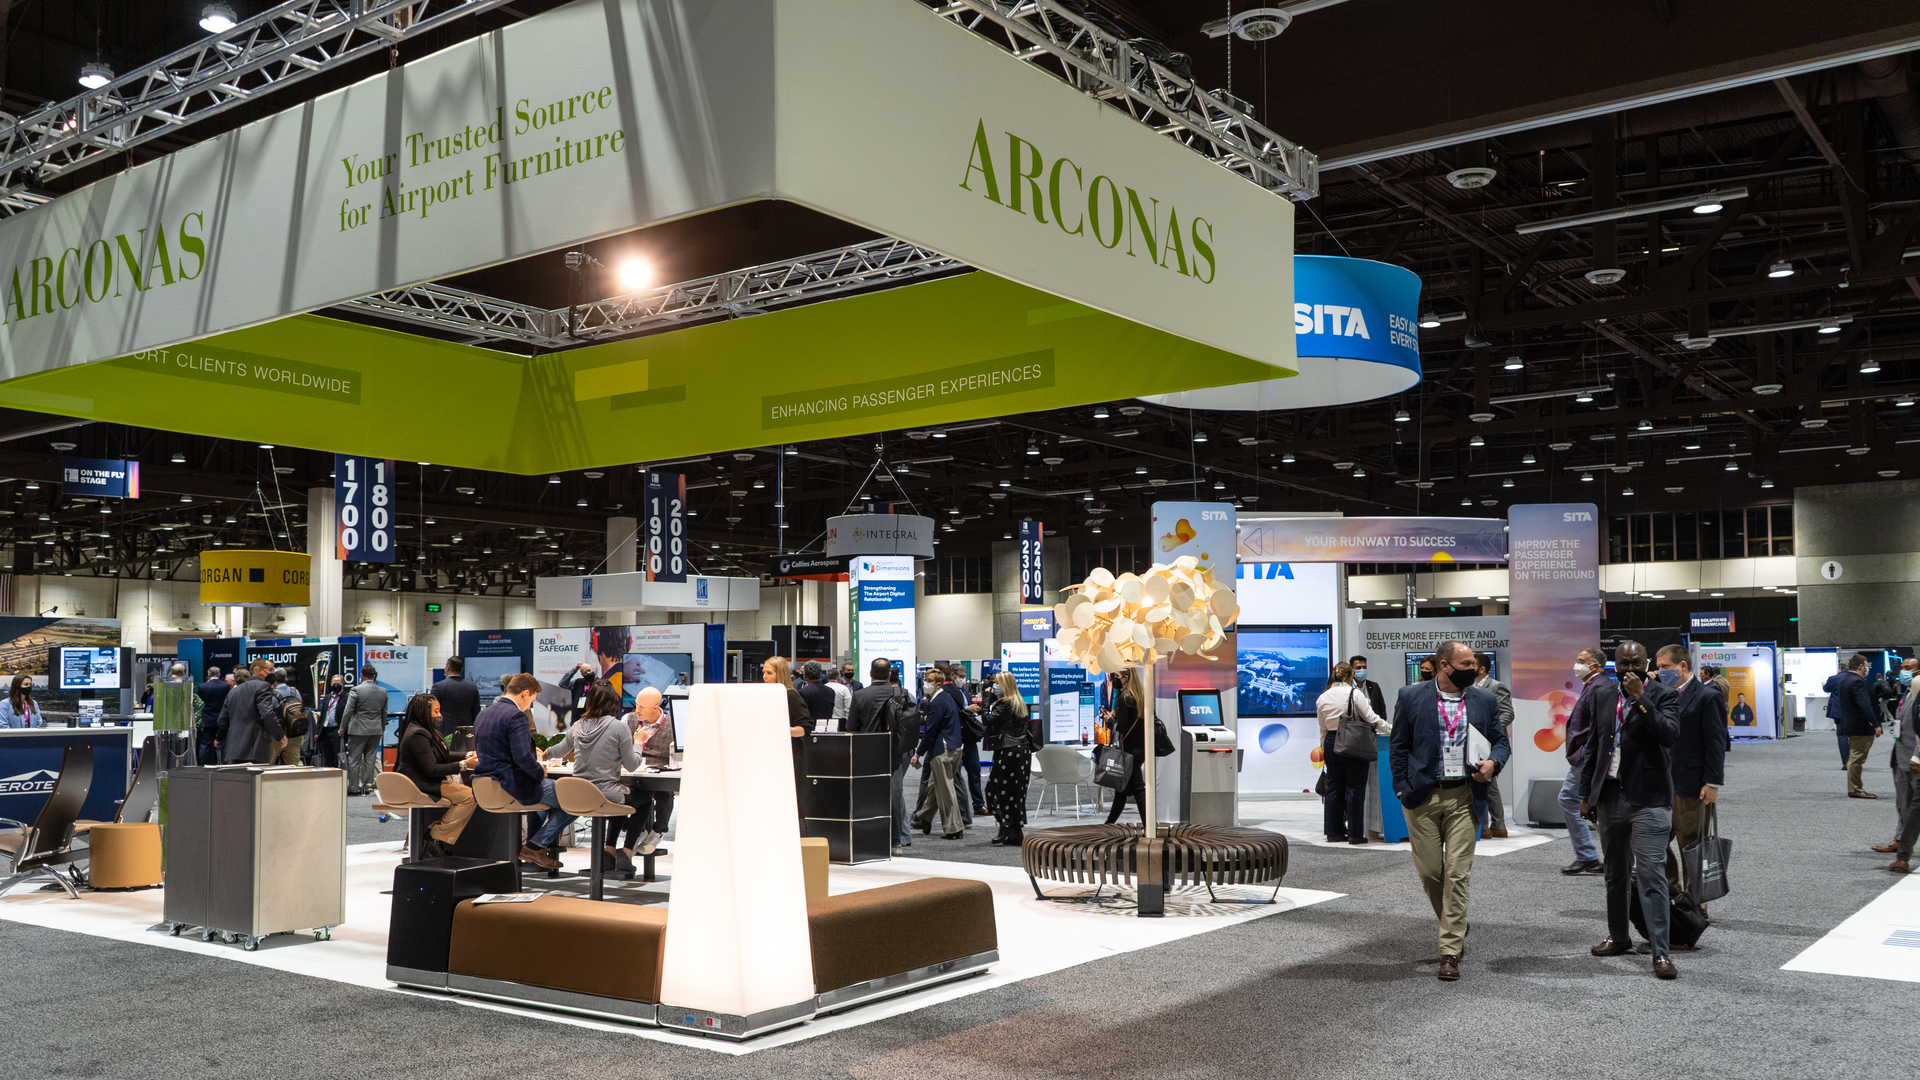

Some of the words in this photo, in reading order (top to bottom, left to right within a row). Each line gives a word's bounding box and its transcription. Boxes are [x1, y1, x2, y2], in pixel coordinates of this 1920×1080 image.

[341, 153, 397, 189] Your
[405, 106, 505, 168] Trusted
[515, 86, 612, 136] Source
[338, 199, 371, 232] for
[378, 169, 475, 219] Airport
[482, 129, 626, 191] Furniture
[958, 117, 1216, 285] ARCONAS
[2, 210, 206, 325] ARCONAS
[1294, 303, 1370, 340] SITA
[1389, 313, 1409, 332] EASY
[1390, 330, 1413, 350] EVERY
[176, 353, 247, 377] CLIENTS
[253, 365, 351, 394] WORLDWIDE
[771, 397, 848, 420] ENHANCING
[852, 383, 936, 409] PASSENGER
[940, 363, 1042, 395] EXPERIENCES
[80, 469, 93, 477] ON
[94, 469, 110, 478] THE
[110, 471, 125, 479] FLY
[80, 476, 107, 485] STAGE
[341, 458, 359, 550] 1700
[371, 462, 388, 552] 1800
[1202, 510, 1228, 521] SITA
[1563, 512, 1592, 522] SITA
[649, 497, 662, 574] 1900
[670, 499, 682, 575] 2000
[866, 529, 918, 540] INTEGRAL
[1304, 536, 1337, 547] YOUR
[1340, 536, 1390, 547] RUNWAY
[1393, 536, 1407, 547] TO
[1409, 536, 1456, 547] SUCCESS
[1514, 540, 1558, 549] IMPROVE
[1560, 539, 1580, 549] THE
[1514, 550, 1573, 559] PASSENGER
[791, 560, 810, 568] Collins
[810, 559, 840, 568] Aerospace
[1022, 540, 1030, 598] 2300
[1033, 540, 1041, 598] 2400
[1515, 560, 1577, 569] EXPERIENCE
[1514, 571, 1529, 580] ON
[1531, 571, 1551, 580] THE
[1552, 570, 1595, 579] GROUND
[1366, 632, 1400, 640] DELIVER
[1402, 632, 1427, 640] MORE
[1428, 631, 1475, 640] EFFECTIVE
[1477, 630, 1496, 639] AND
[539, 644, 579, 652] SAFEGATE
[1366, 641, 1434, 650] COST-EFFICIENT
[1475, 639, 1510, 648] OPERAT
[268, 653, 298, 664] ELLIOTT
[1701, 652, 1737, 661] eetags
[1189, 706, 1213, 715] SITA
